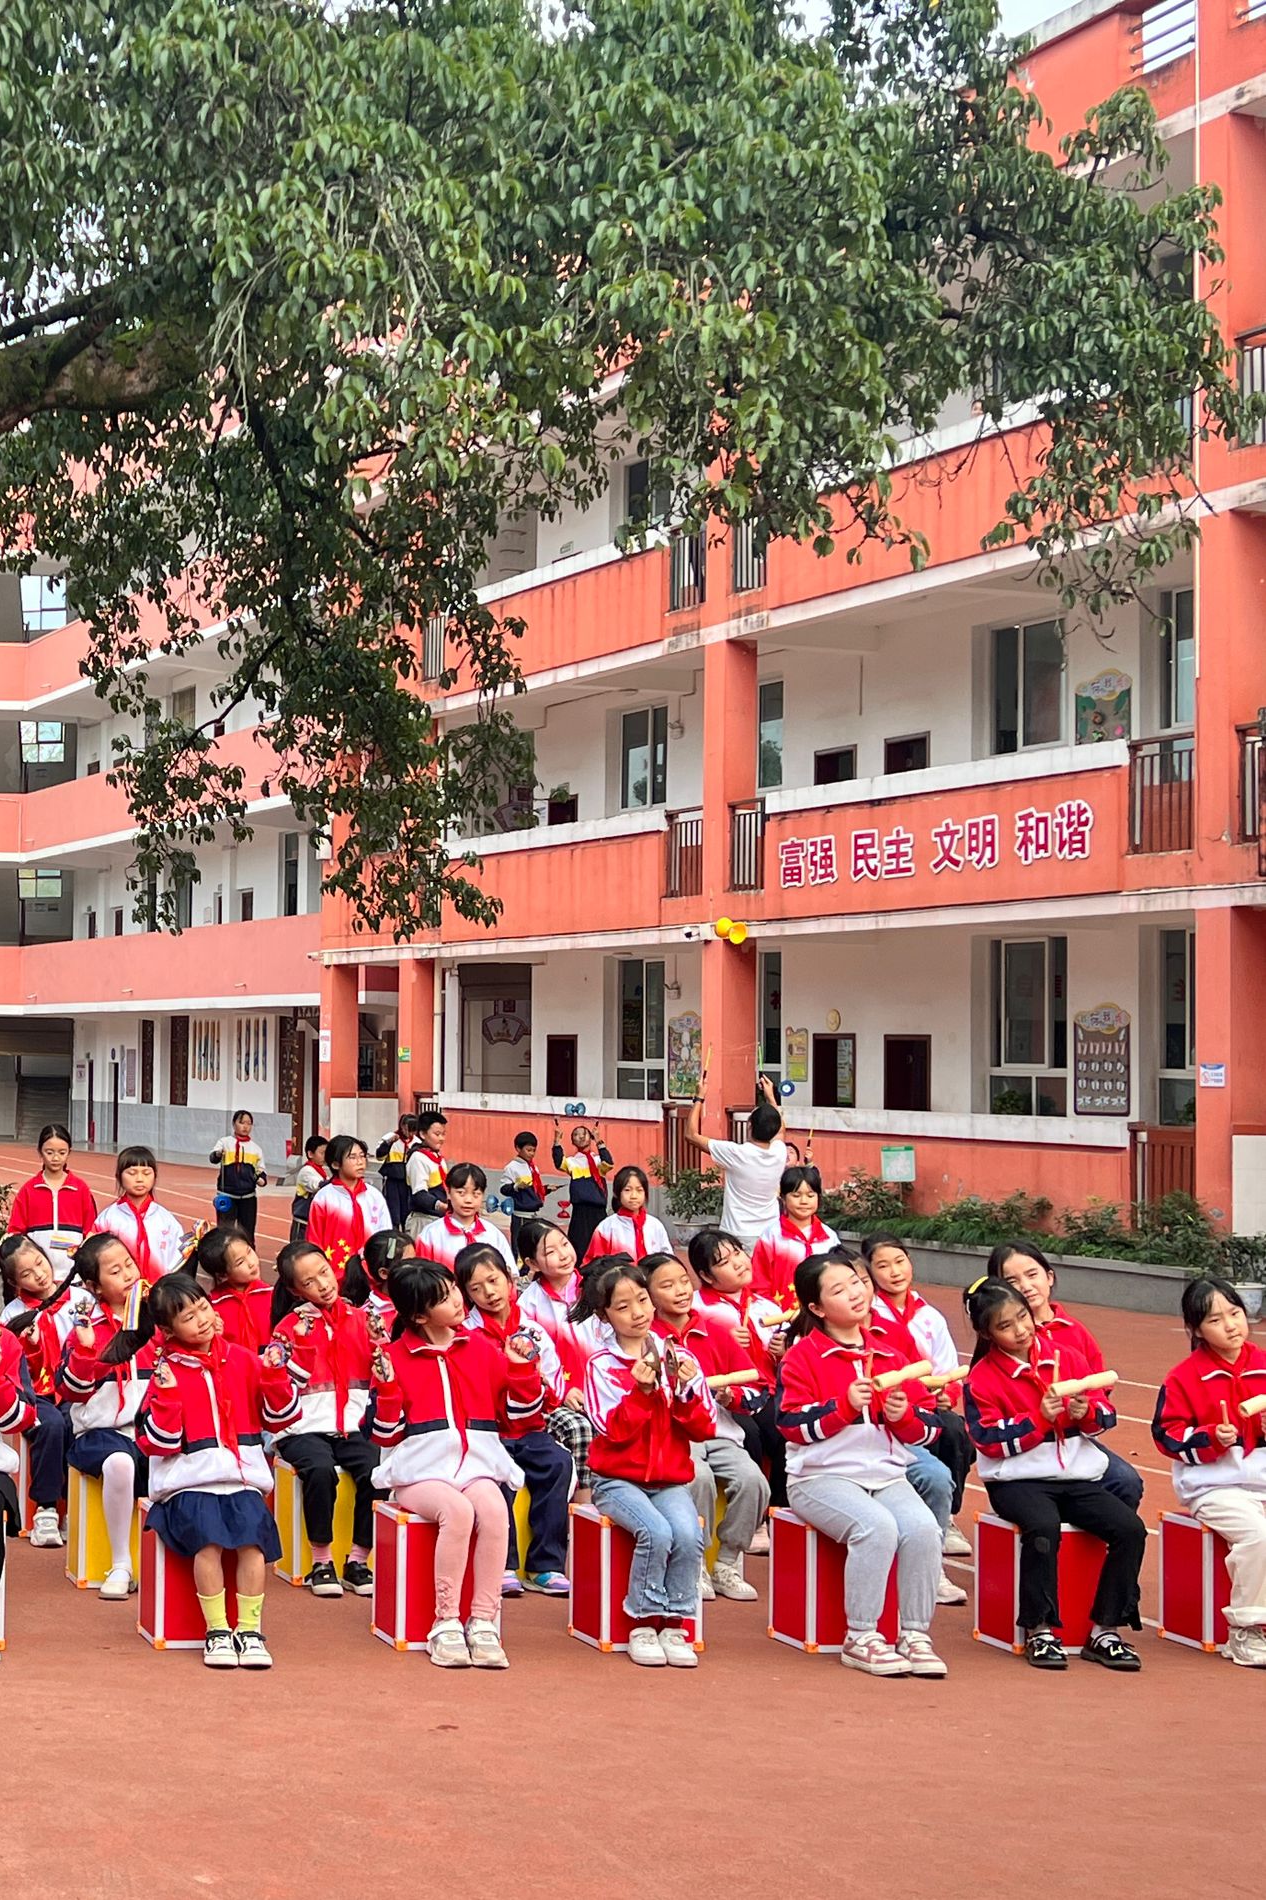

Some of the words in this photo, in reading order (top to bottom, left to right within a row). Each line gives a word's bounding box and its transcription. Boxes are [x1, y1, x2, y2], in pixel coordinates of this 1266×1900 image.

[779, 835, 838, 889] 富强
[851, 826, 914, 881] 民主
[931, 814, 1000, 874] 文明
[1015, 798, 1095, 866] 和谐
